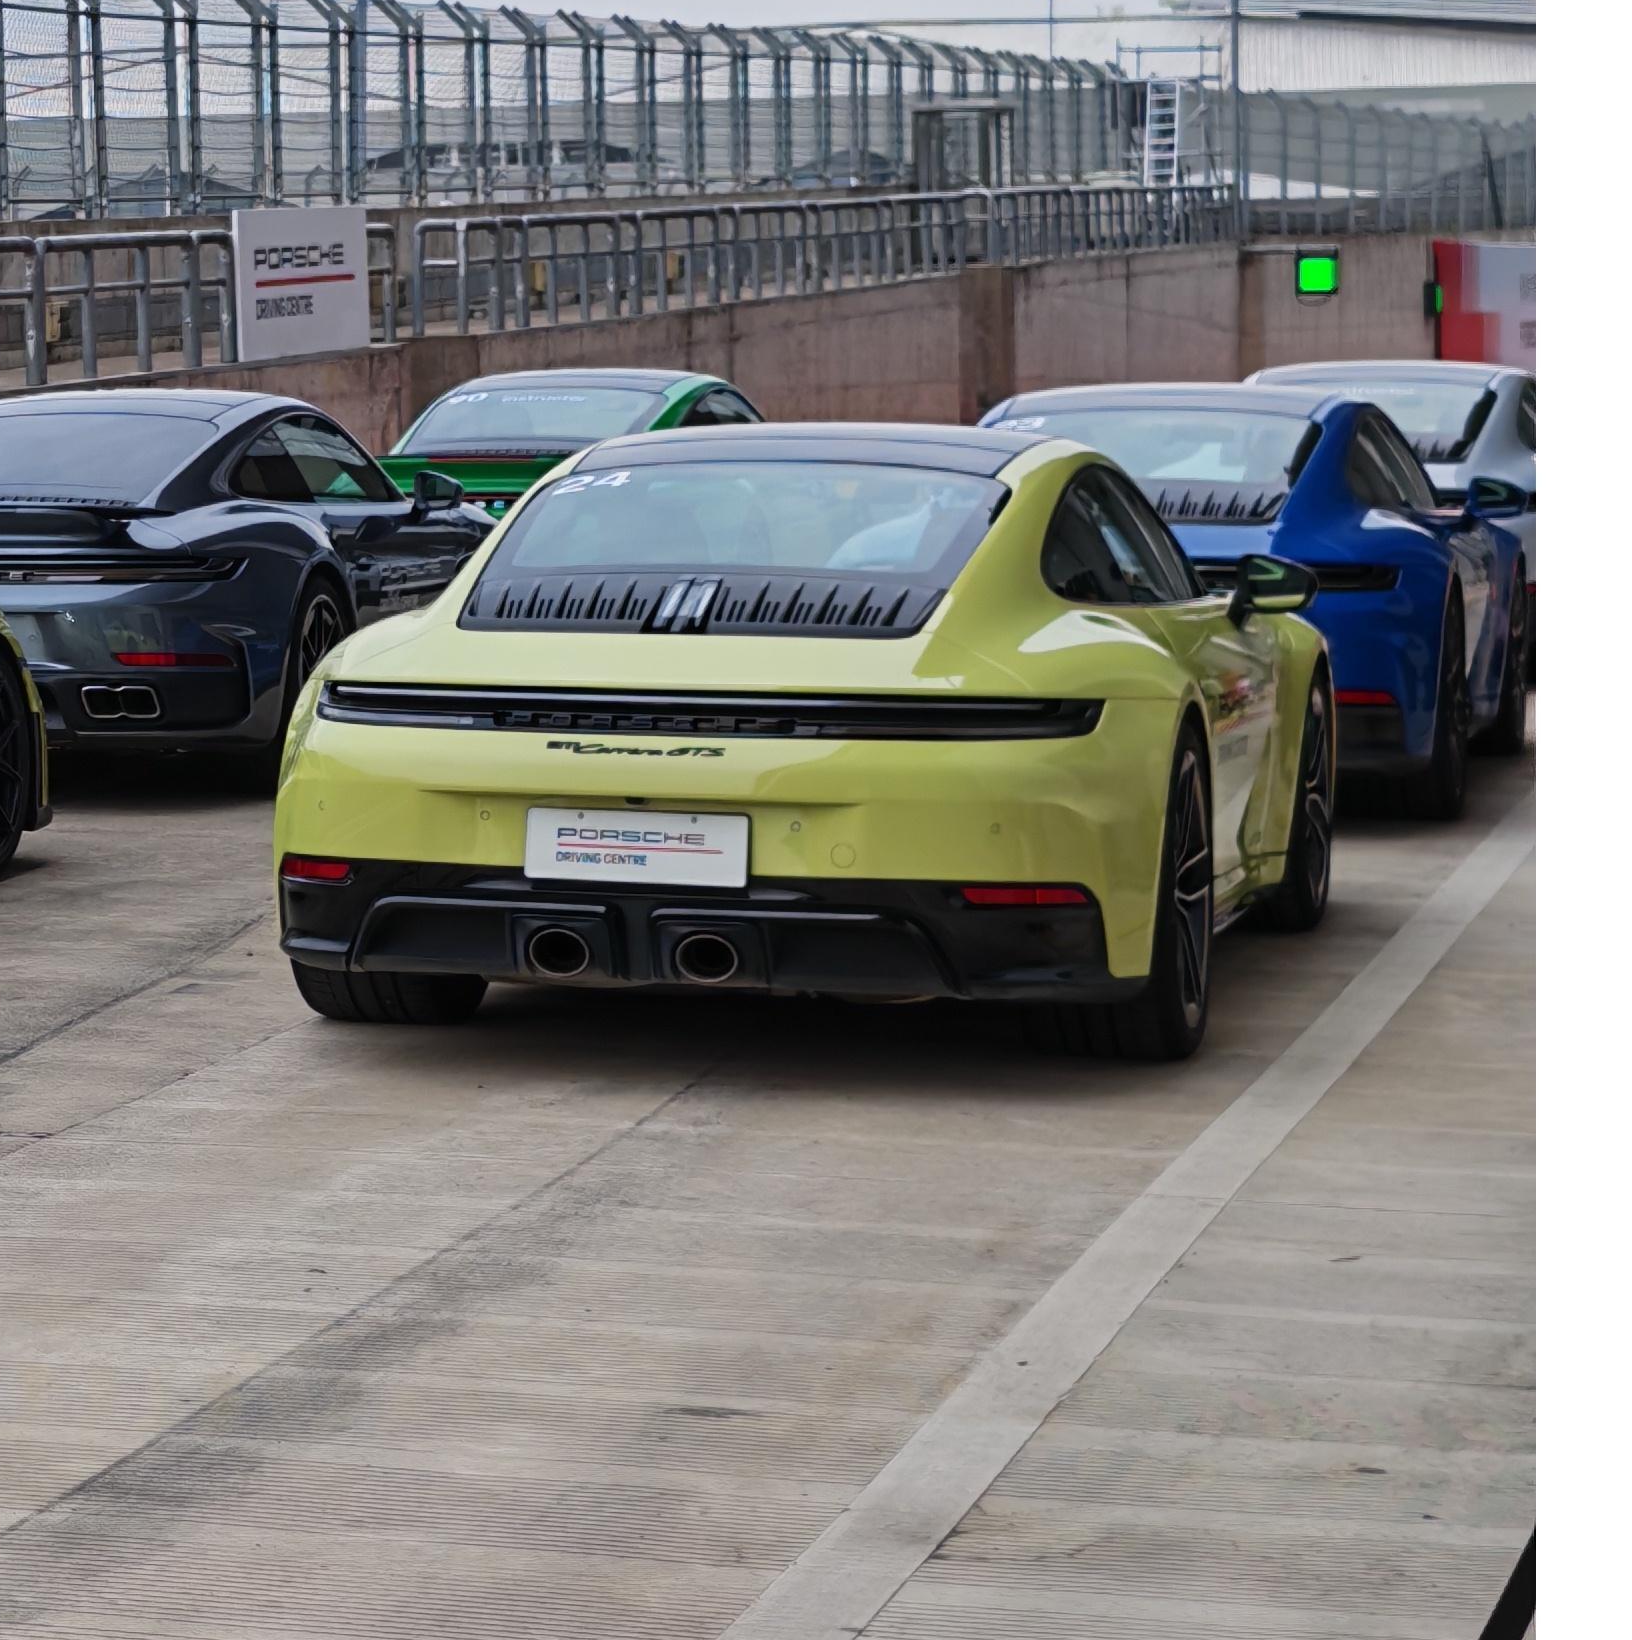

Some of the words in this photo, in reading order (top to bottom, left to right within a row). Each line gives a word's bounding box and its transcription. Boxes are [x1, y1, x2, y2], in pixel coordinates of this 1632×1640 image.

[254, 243, 344, 270] PORSCHE
[552, 471, 632, 496] 24
[666, 747, 726, 757] GTS
[557, 827, 706, 846] PORSCHE
[555, 851, 601, 864] DRIVING
[603, 853, 647, 866] CENTRE
